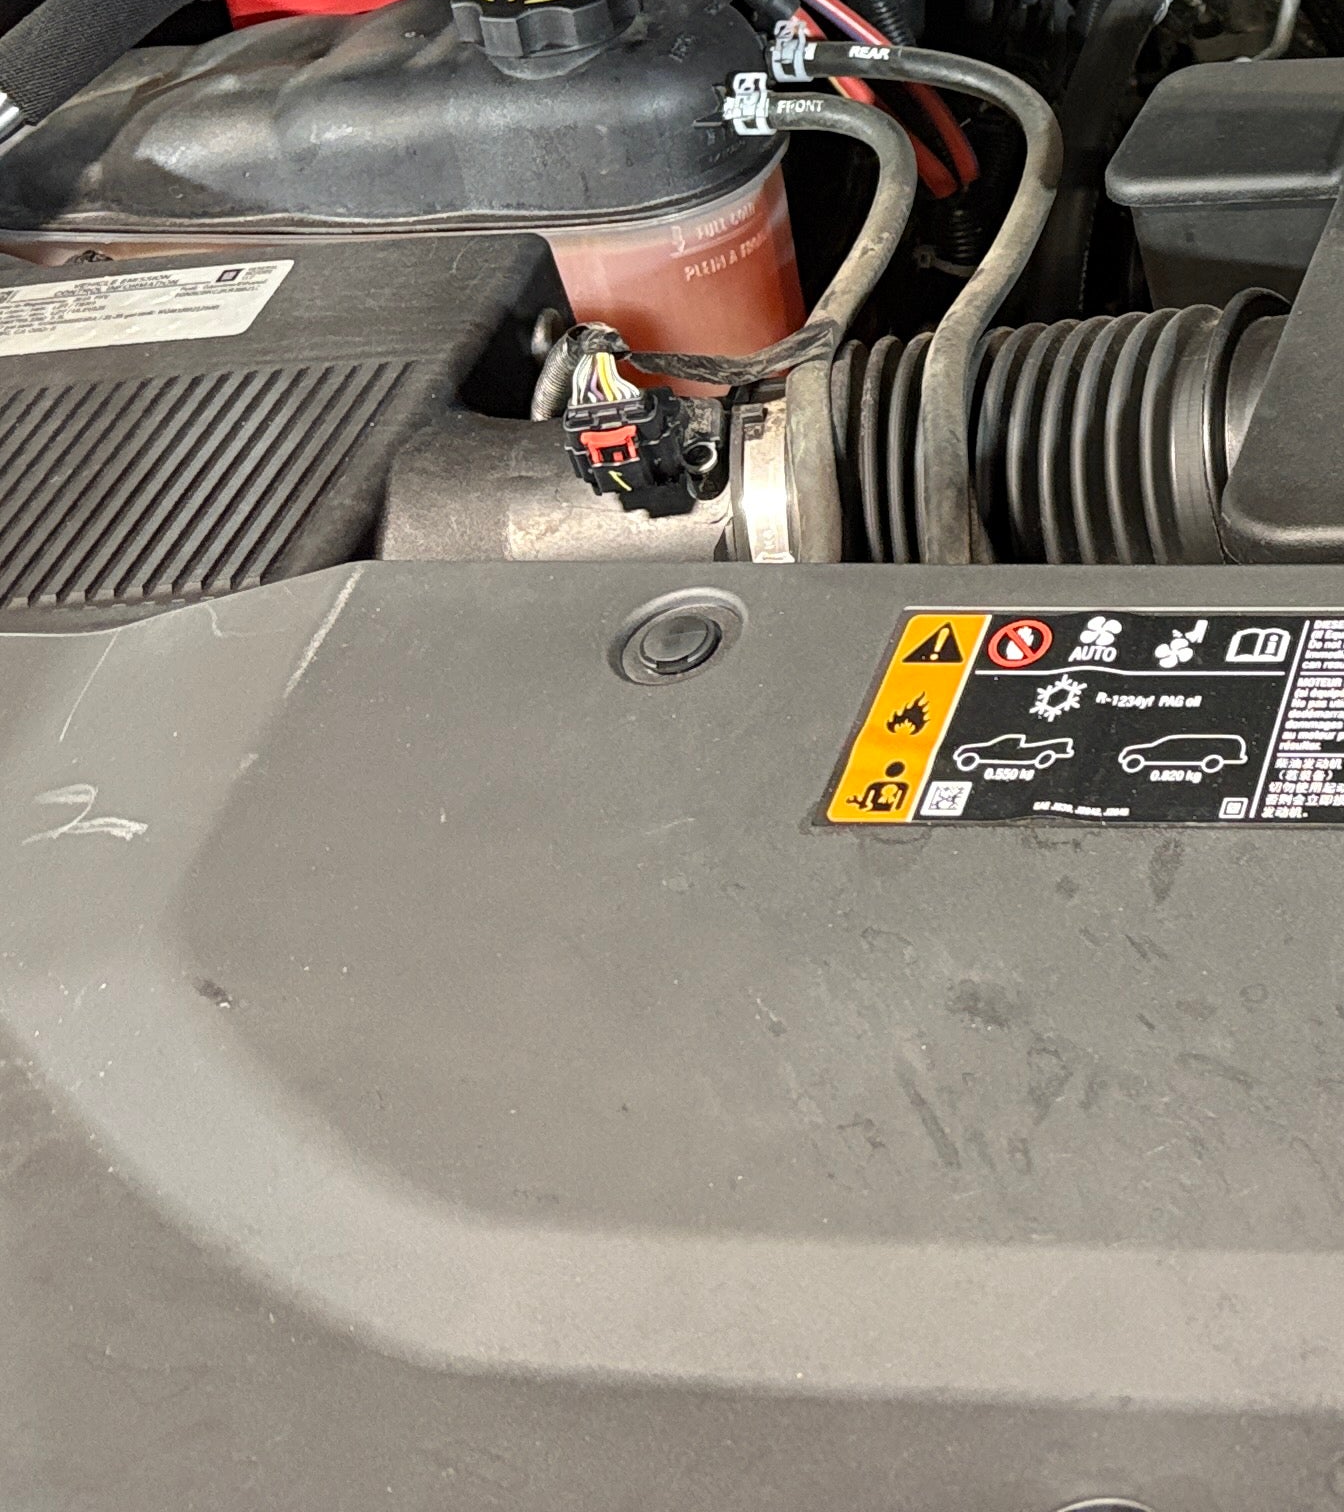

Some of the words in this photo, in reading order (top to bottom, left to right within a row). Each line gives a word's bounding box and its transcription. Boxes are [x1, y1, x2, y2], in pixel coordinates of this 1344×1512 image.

[849, 46, 890, 60] REAR
[776, 99, 824, 114] FRONT
[1068, 645, 1117, 663] AUTO
[1095, 692, 1155, 709] R-1234yf
[1158, 696, 1185, 708] PAG
[1018, 768, 1035, 781] kg
[1186, 770, 1202, 783] kg
